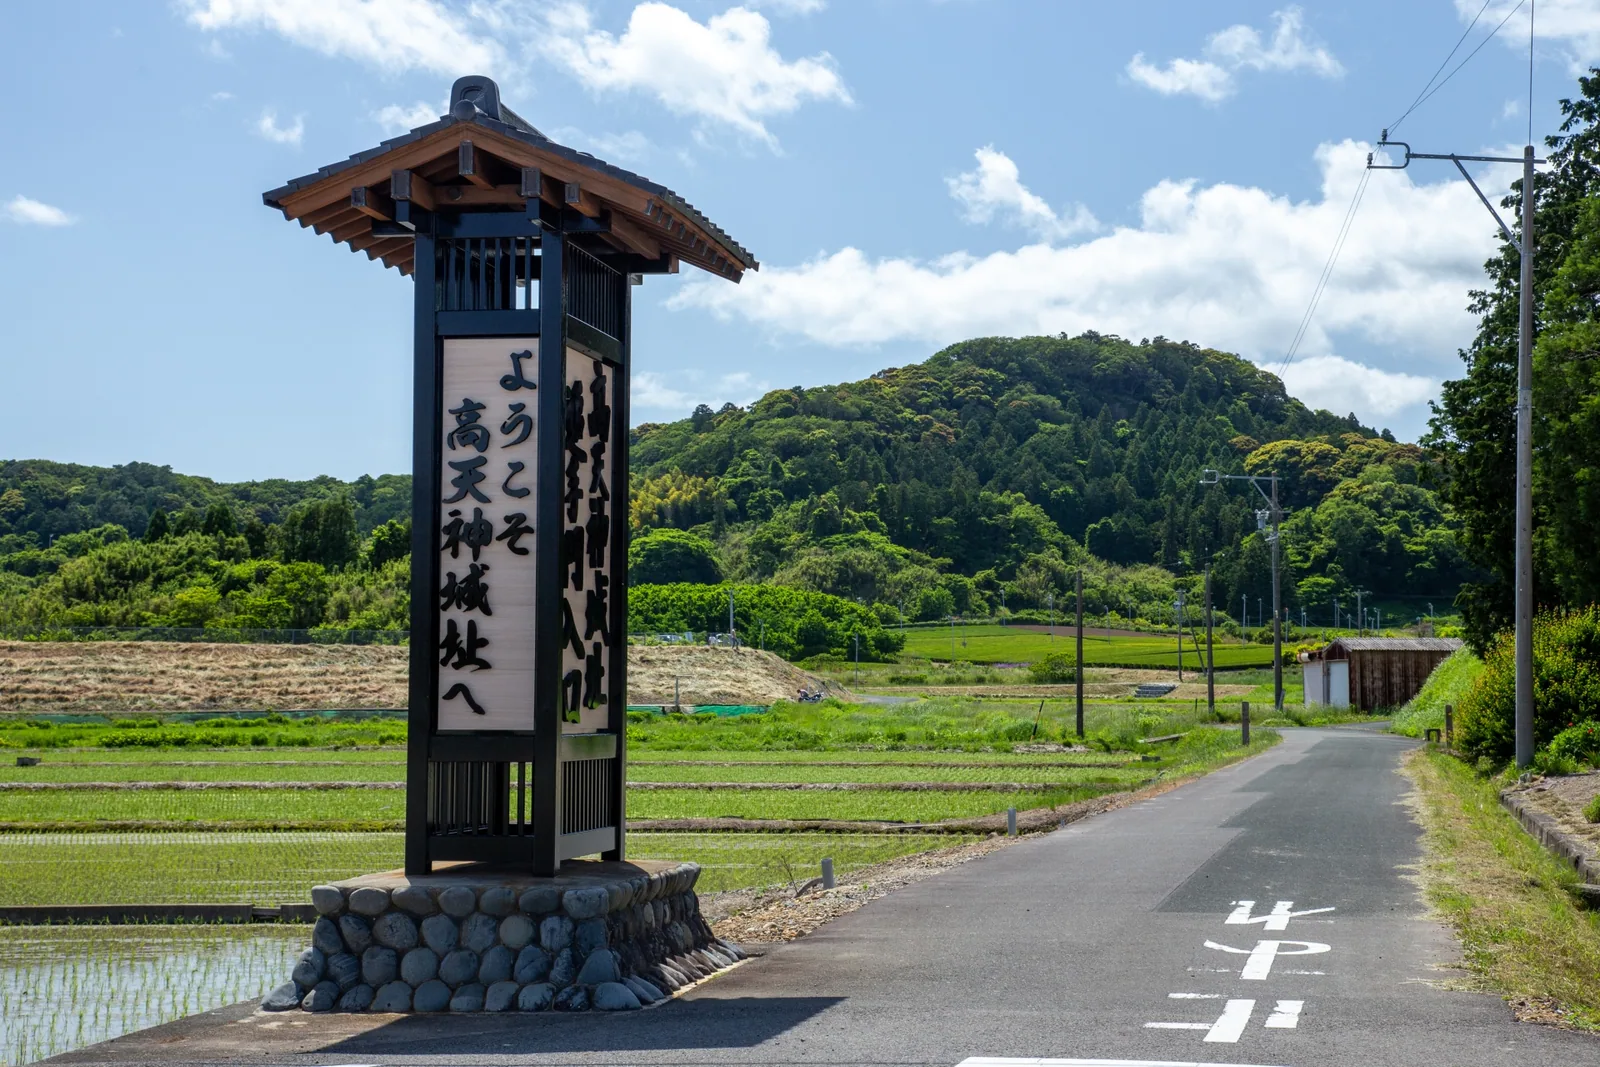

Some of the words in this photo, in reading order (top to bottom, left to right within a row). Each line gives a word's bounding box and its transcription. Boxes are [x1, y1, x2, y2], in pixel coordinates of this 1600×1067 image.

[440, 398, 493, 715] 高天神城址へ
[496, 350, 537, 556] ようこそ
